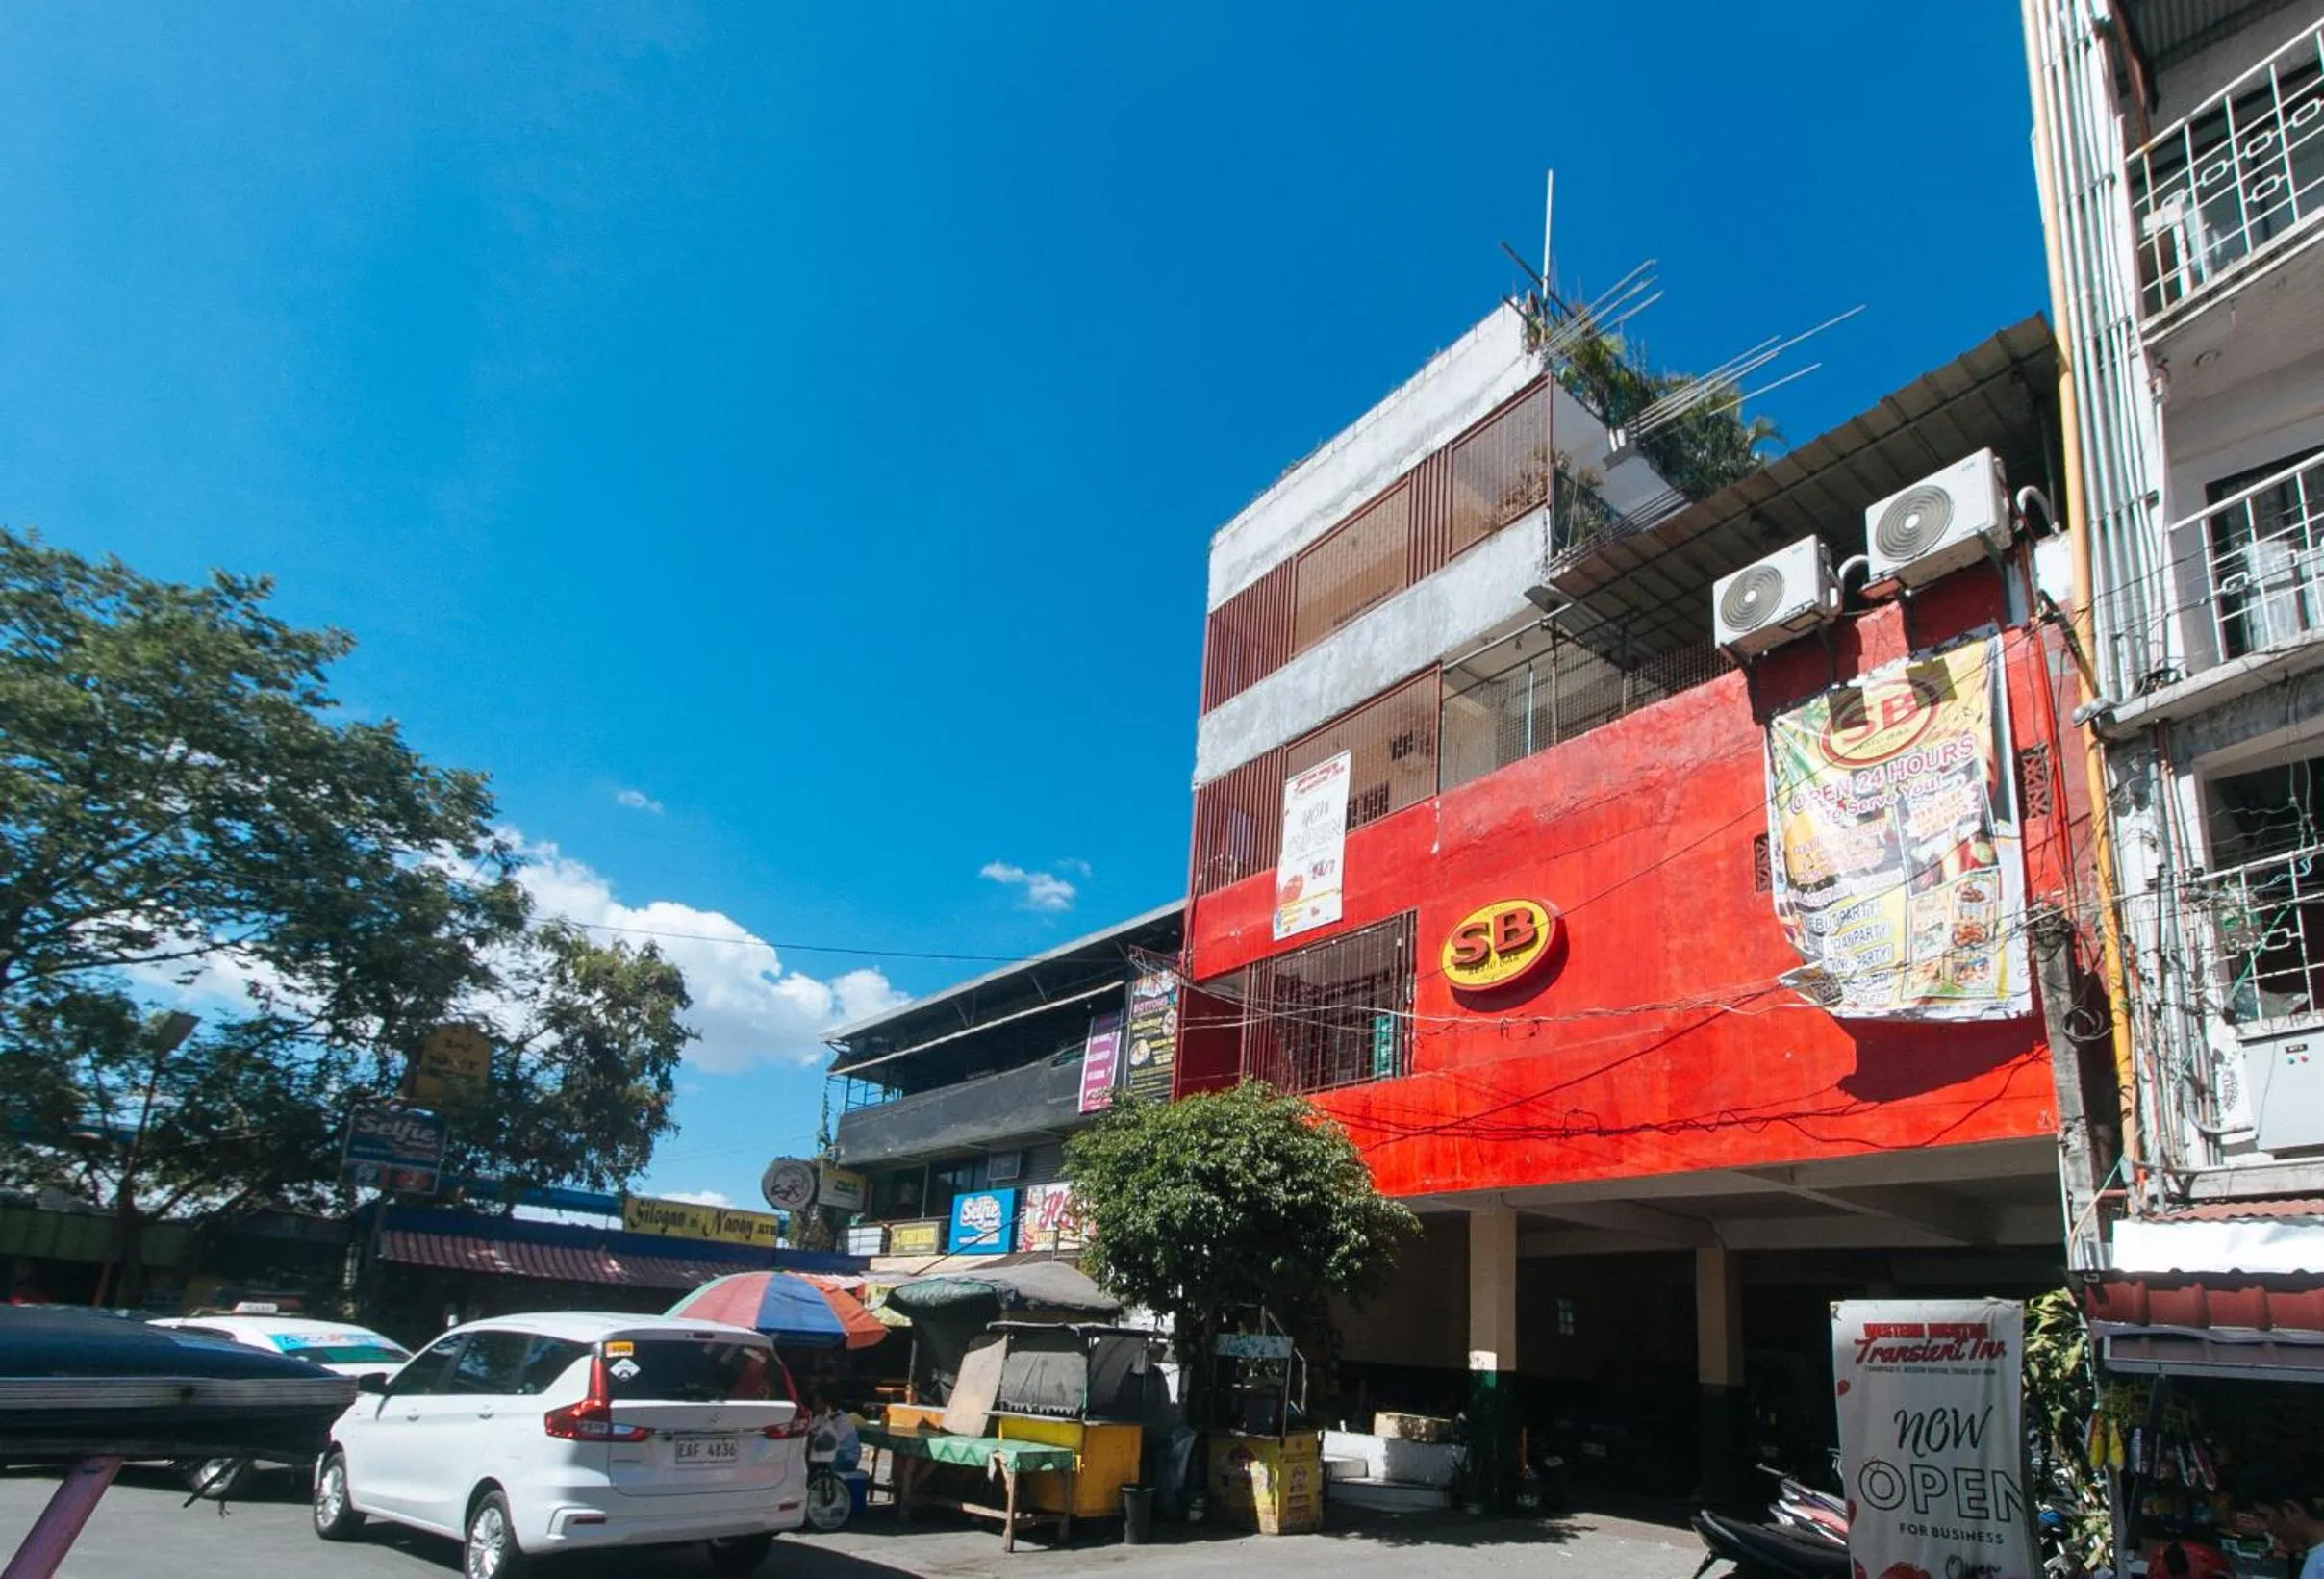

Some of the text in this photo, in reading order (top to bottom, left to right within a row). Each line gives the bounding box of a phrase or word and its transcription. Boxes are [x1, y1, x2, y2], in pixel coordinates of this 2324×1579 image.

[1857, 769, 1885, 792] 24
[1888, 732, 1977, 782] HOURS
[1450, 907, 1538, 967] SB
[354, 1114, 437, 1142] Selfie
[1854, 1335, 2008, 1364] Transient Inn
[1858, 1460, 2025, 1522] OPEN
[1899, 1522, 2005, 1545] FOR BUSINESS
